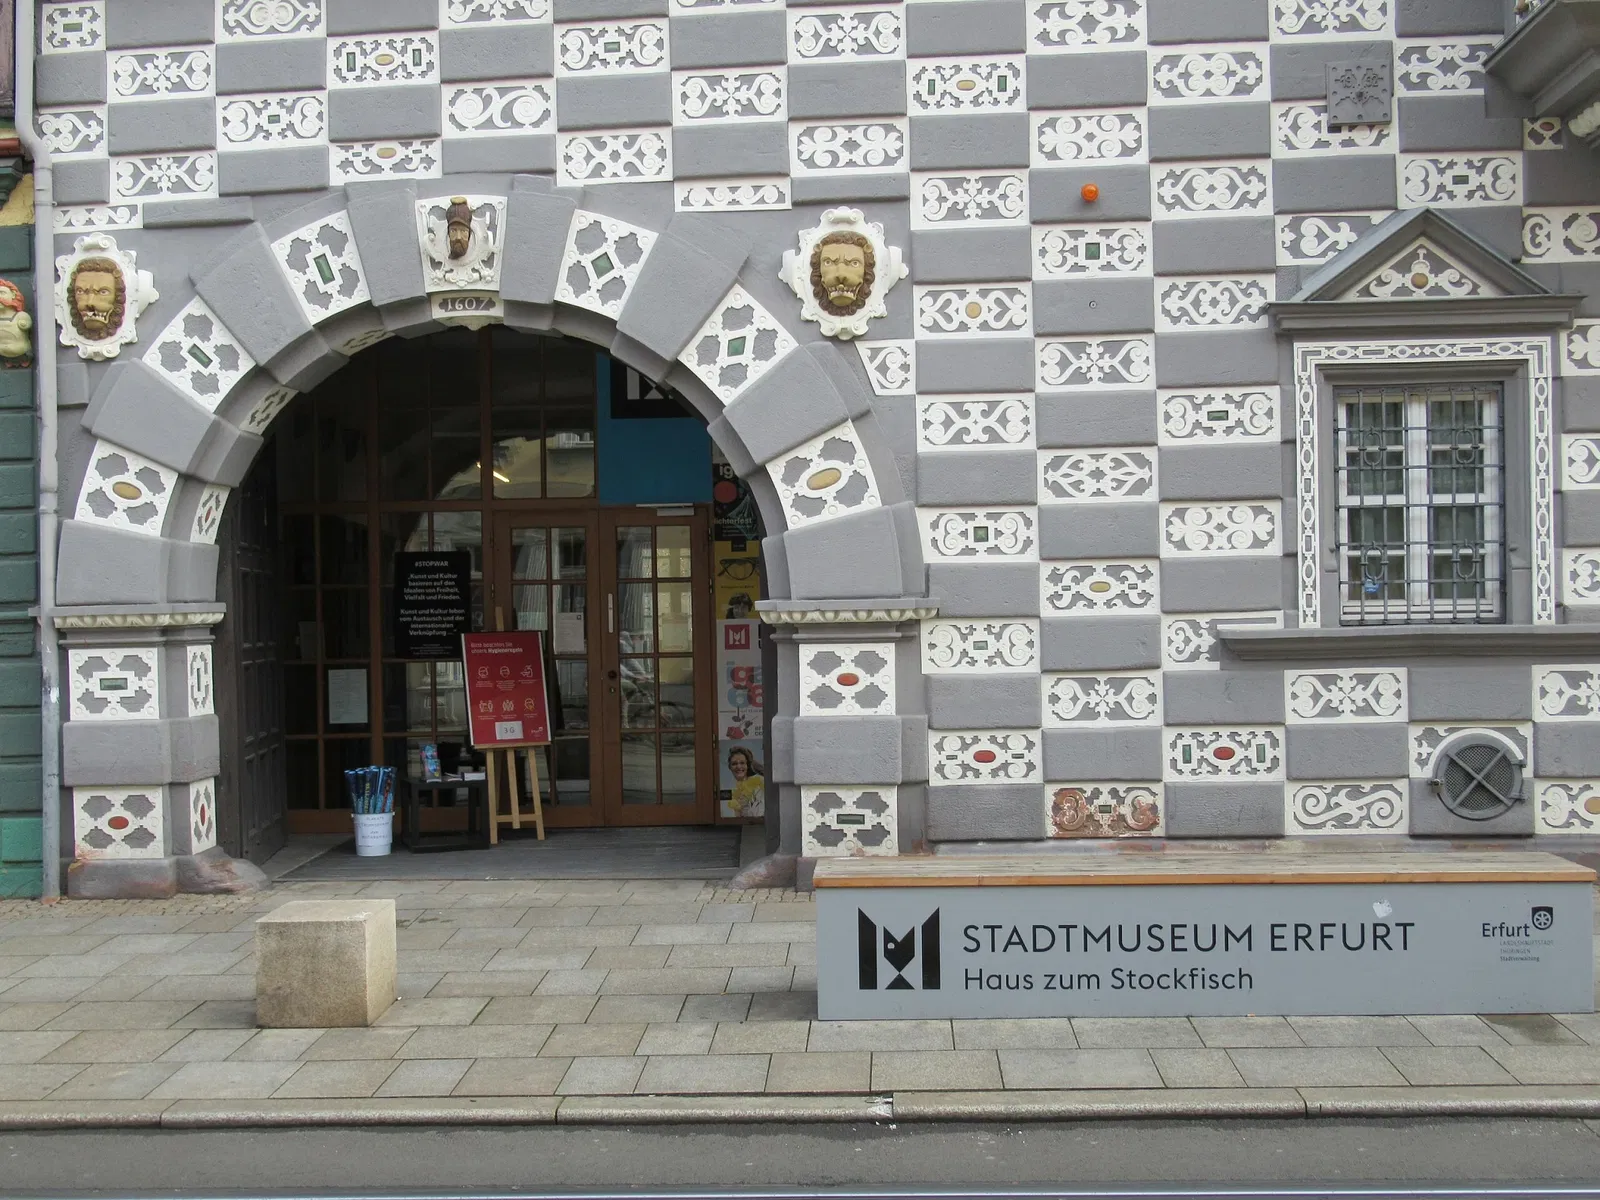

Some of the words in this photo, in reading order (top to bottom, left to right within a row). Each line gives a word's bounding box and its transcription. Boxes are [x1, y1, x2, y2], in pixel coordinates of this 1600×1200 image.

[447, 297, 490, 311] 1607
[719, 463, 733, 479] ig
[509, 726, 515, 734] G
[1482, 922, 1530, 937] Erfurt
[962, 924, 1253, 953] STADTMUSEUM
[1270, 923, 1415, 951] ERFURT
[964, 968, 1034, 990] Haus
[1044, 973, 1100, 990] zum
[1111, 967, 1253, 990] Stockfisch
